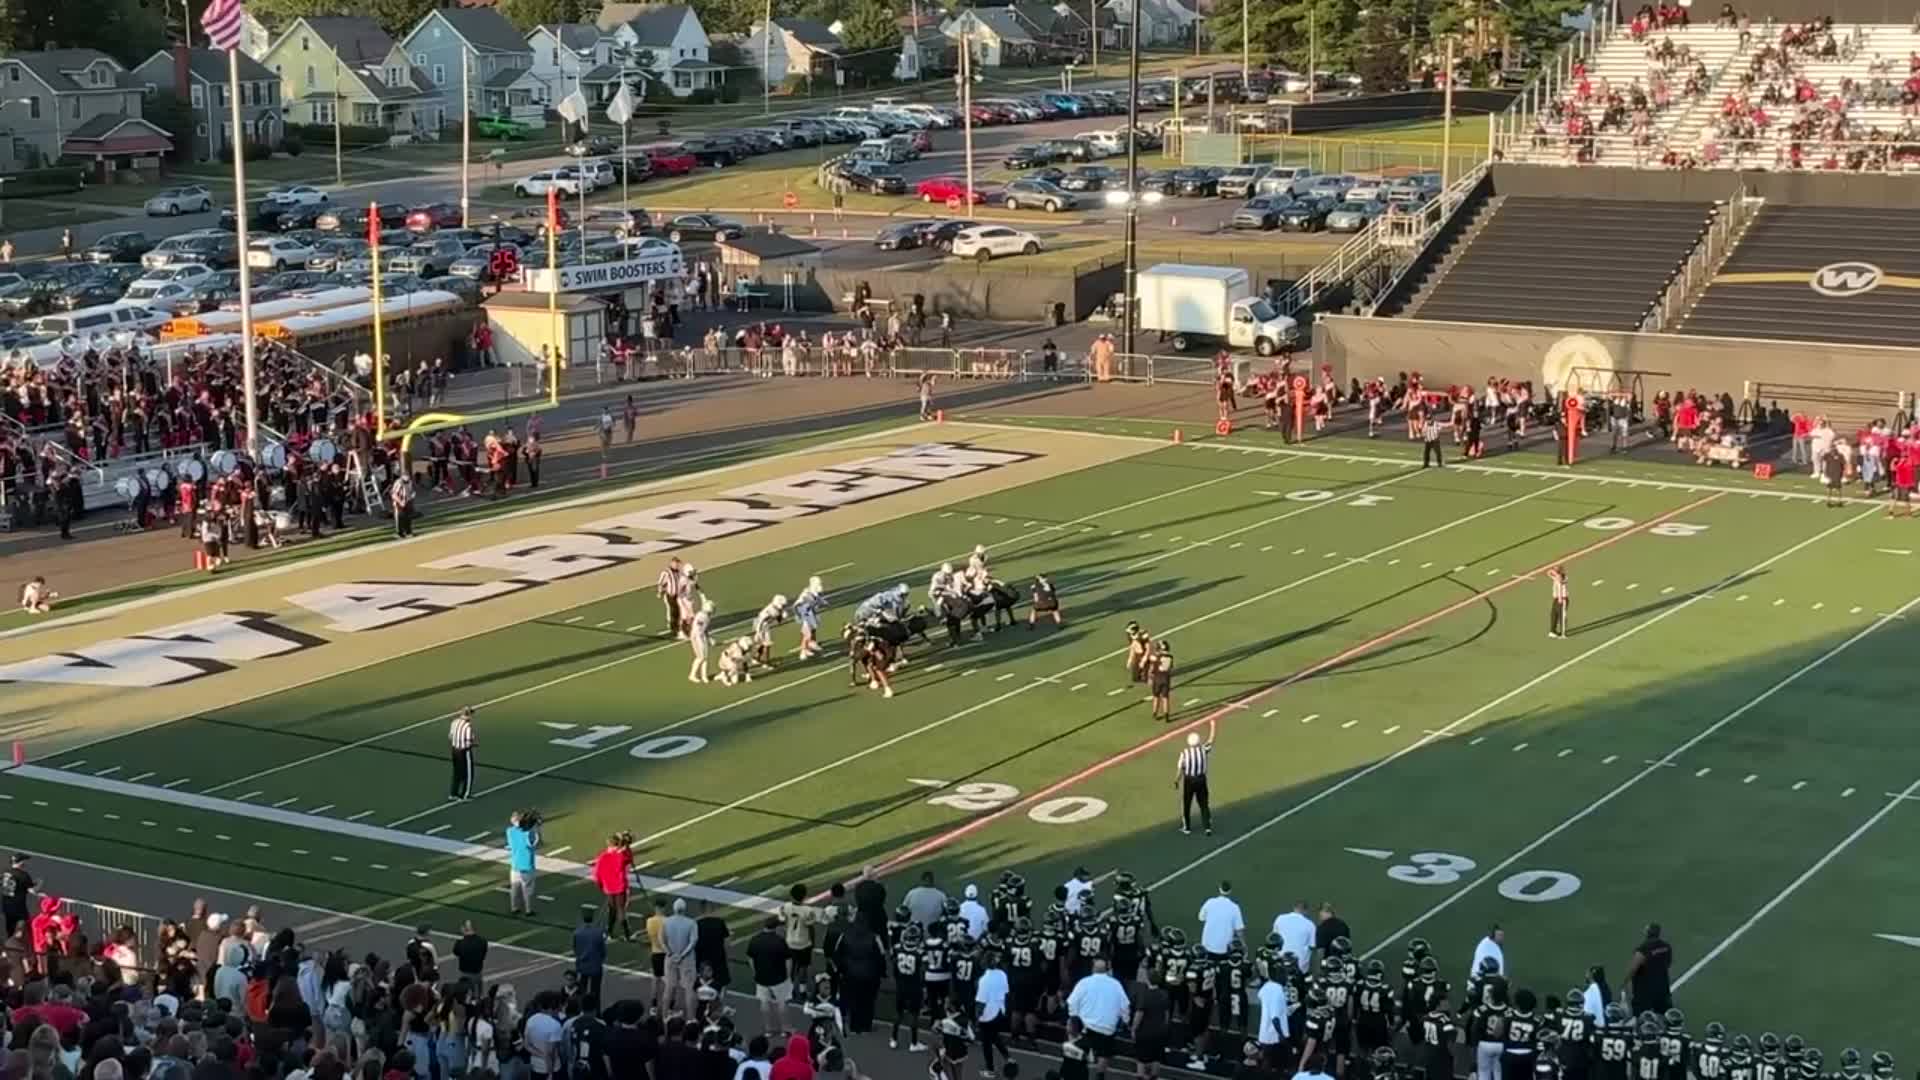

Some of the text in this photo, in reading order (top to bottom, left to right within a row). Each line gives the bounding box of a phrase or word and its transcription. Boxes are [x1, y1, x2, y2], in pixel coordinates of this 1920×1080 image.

[491, 251, 514, 273] 25
[575, 261, 666, 285] SWIM BOOSTERS
[1823, 270, 1875, 288] W
[0, 441, 1048, 687] WARREN
[548, 724, 708, 759] 10
[927, 782, 1109, 824] 20
[1387, 852, 1582, 903] 30
[1011, 947, 1032, 967] 79
[1079, 936, 1101, 957] 99
[1561, 1018, 1584, 1041] 72
[1602, 1037, 1626, 1061] 59
